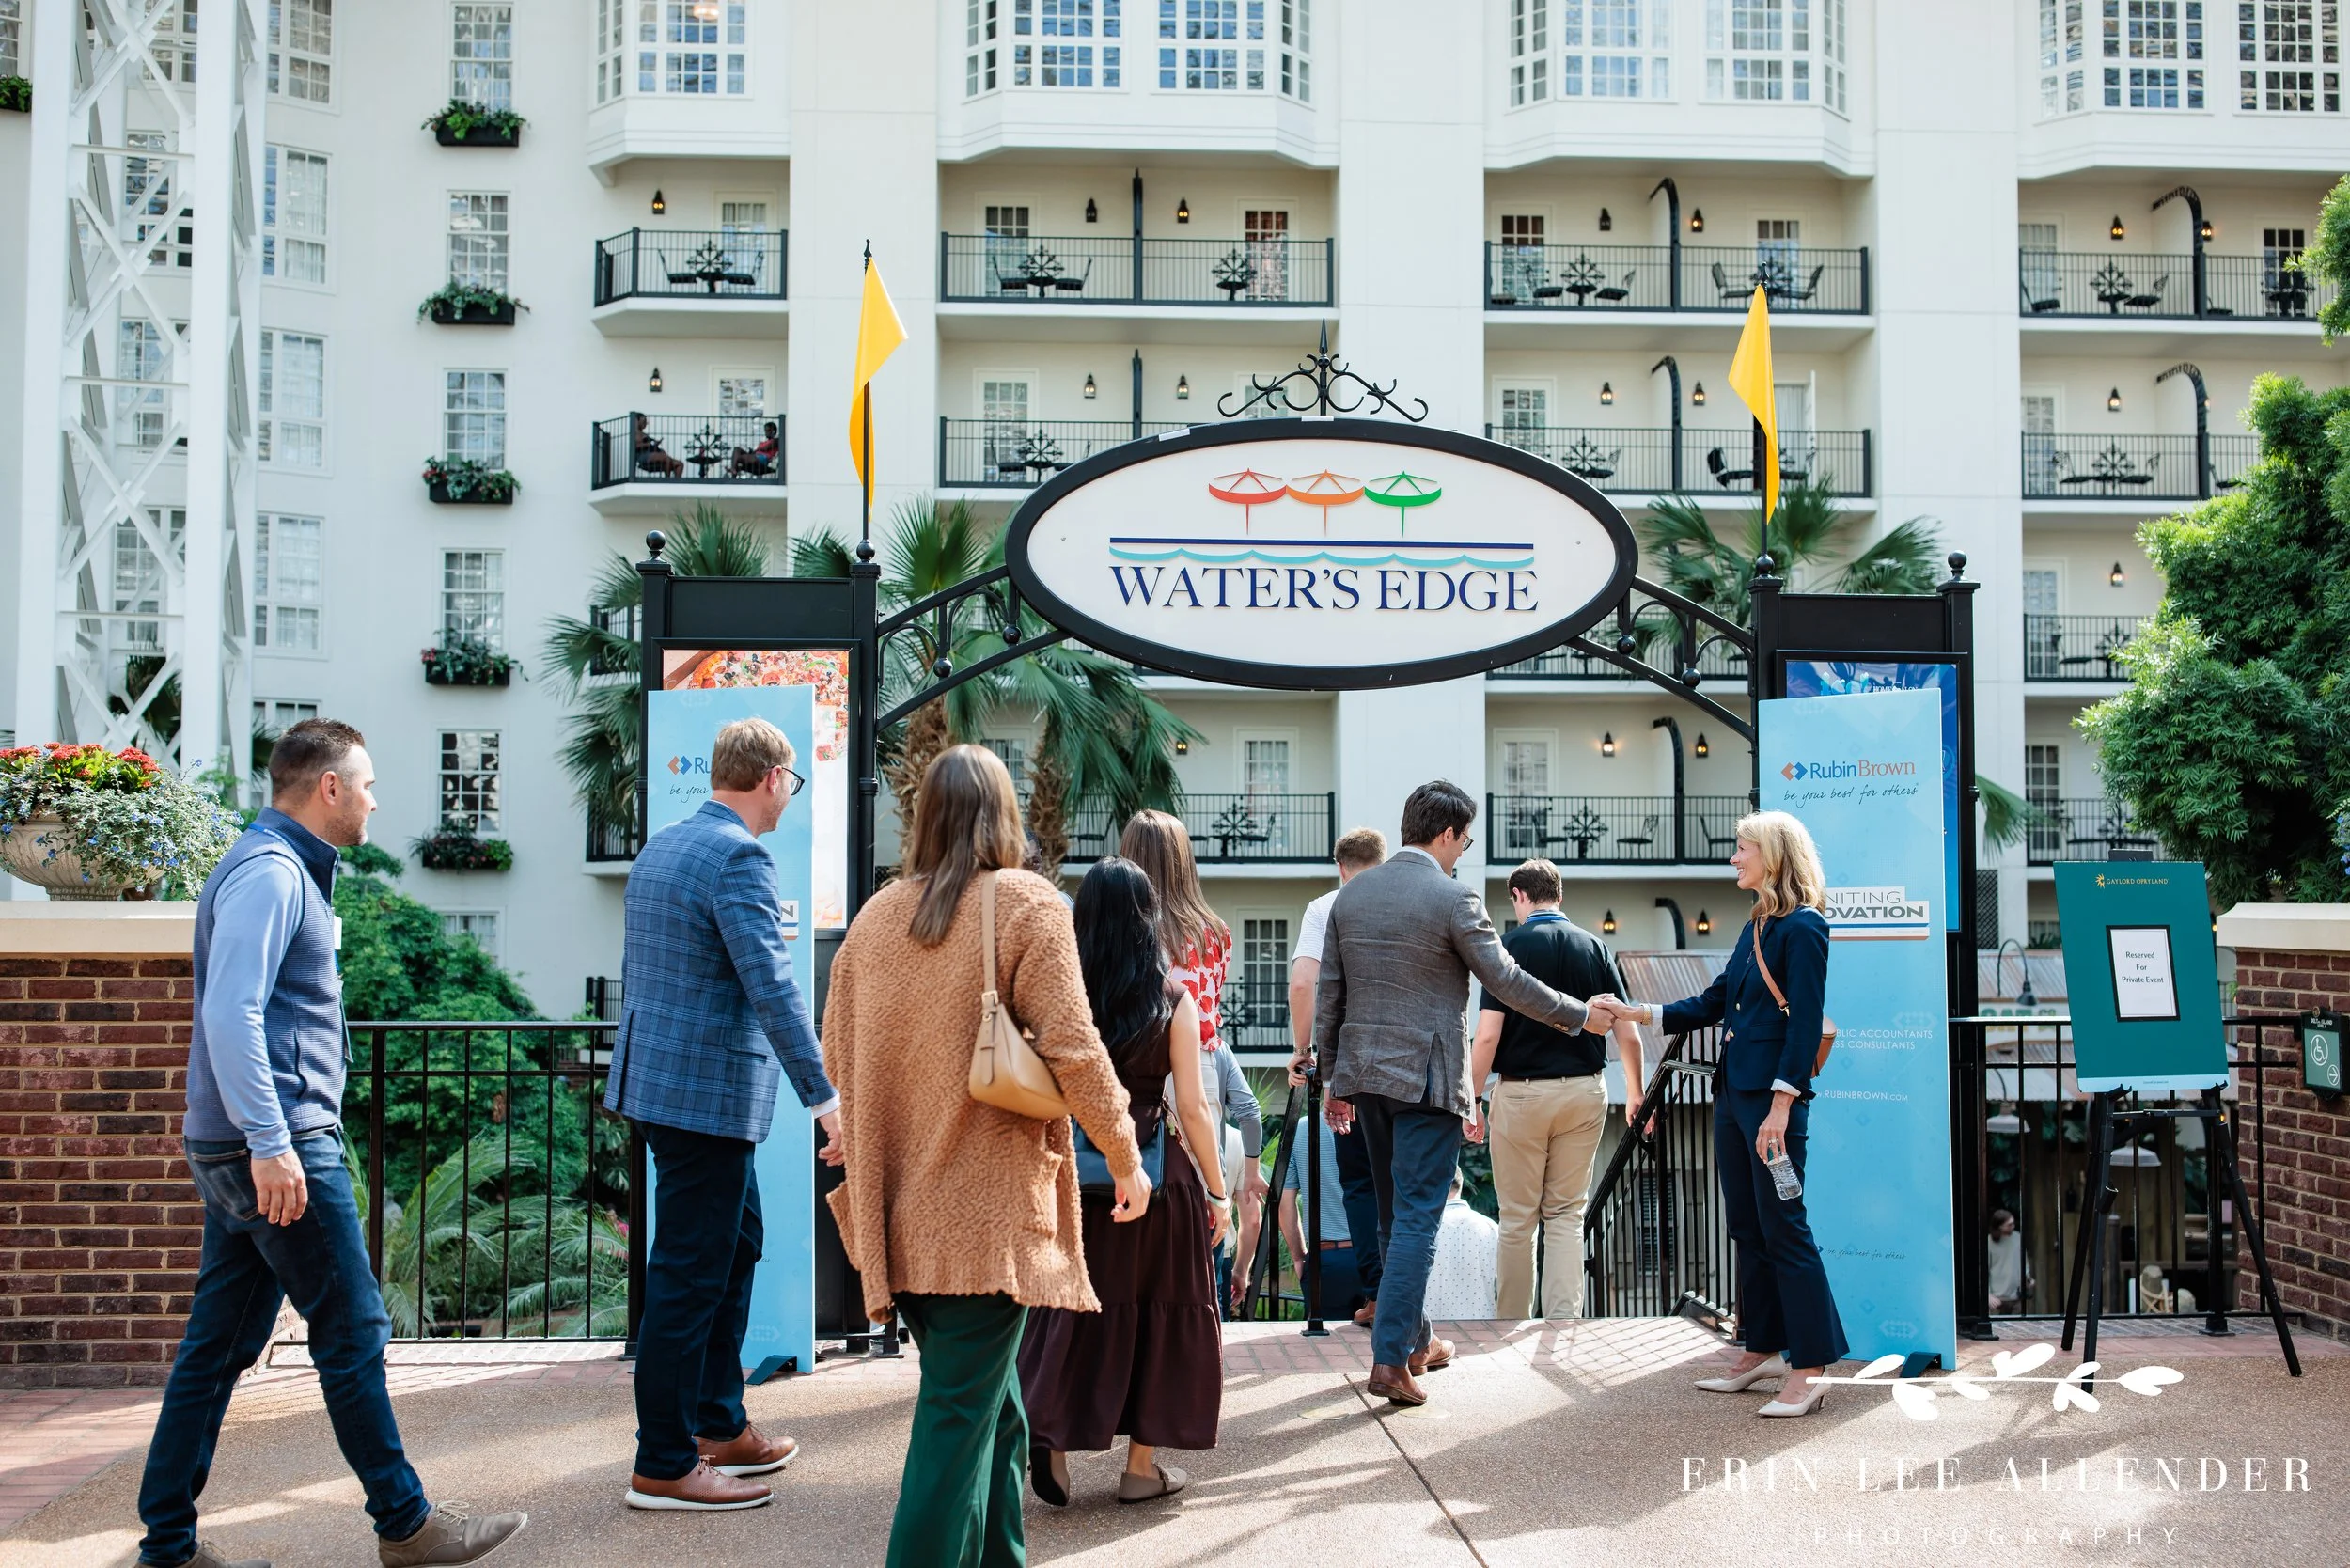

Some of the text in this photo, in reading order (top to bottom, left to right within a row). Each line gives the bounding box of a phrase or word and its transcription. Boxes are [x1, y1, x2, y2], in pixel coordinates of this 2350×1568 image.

[1109, 566, 1539, 612] WATER'S EDGE
[1810, 760, 1916, 779] RubinBrown
[669, 784, 710, 803] be your
[1783, 790, 1797, 801] be
[1795, 790, 1826, 808] your
[1830, 786, 1856, 800] best
[1858, 784, 1879, 805] for
[1860, 1029, 1934, 1039] ACCOUNTANTS
[1848, 1040, 1916, 1050] CONSULTANTS
